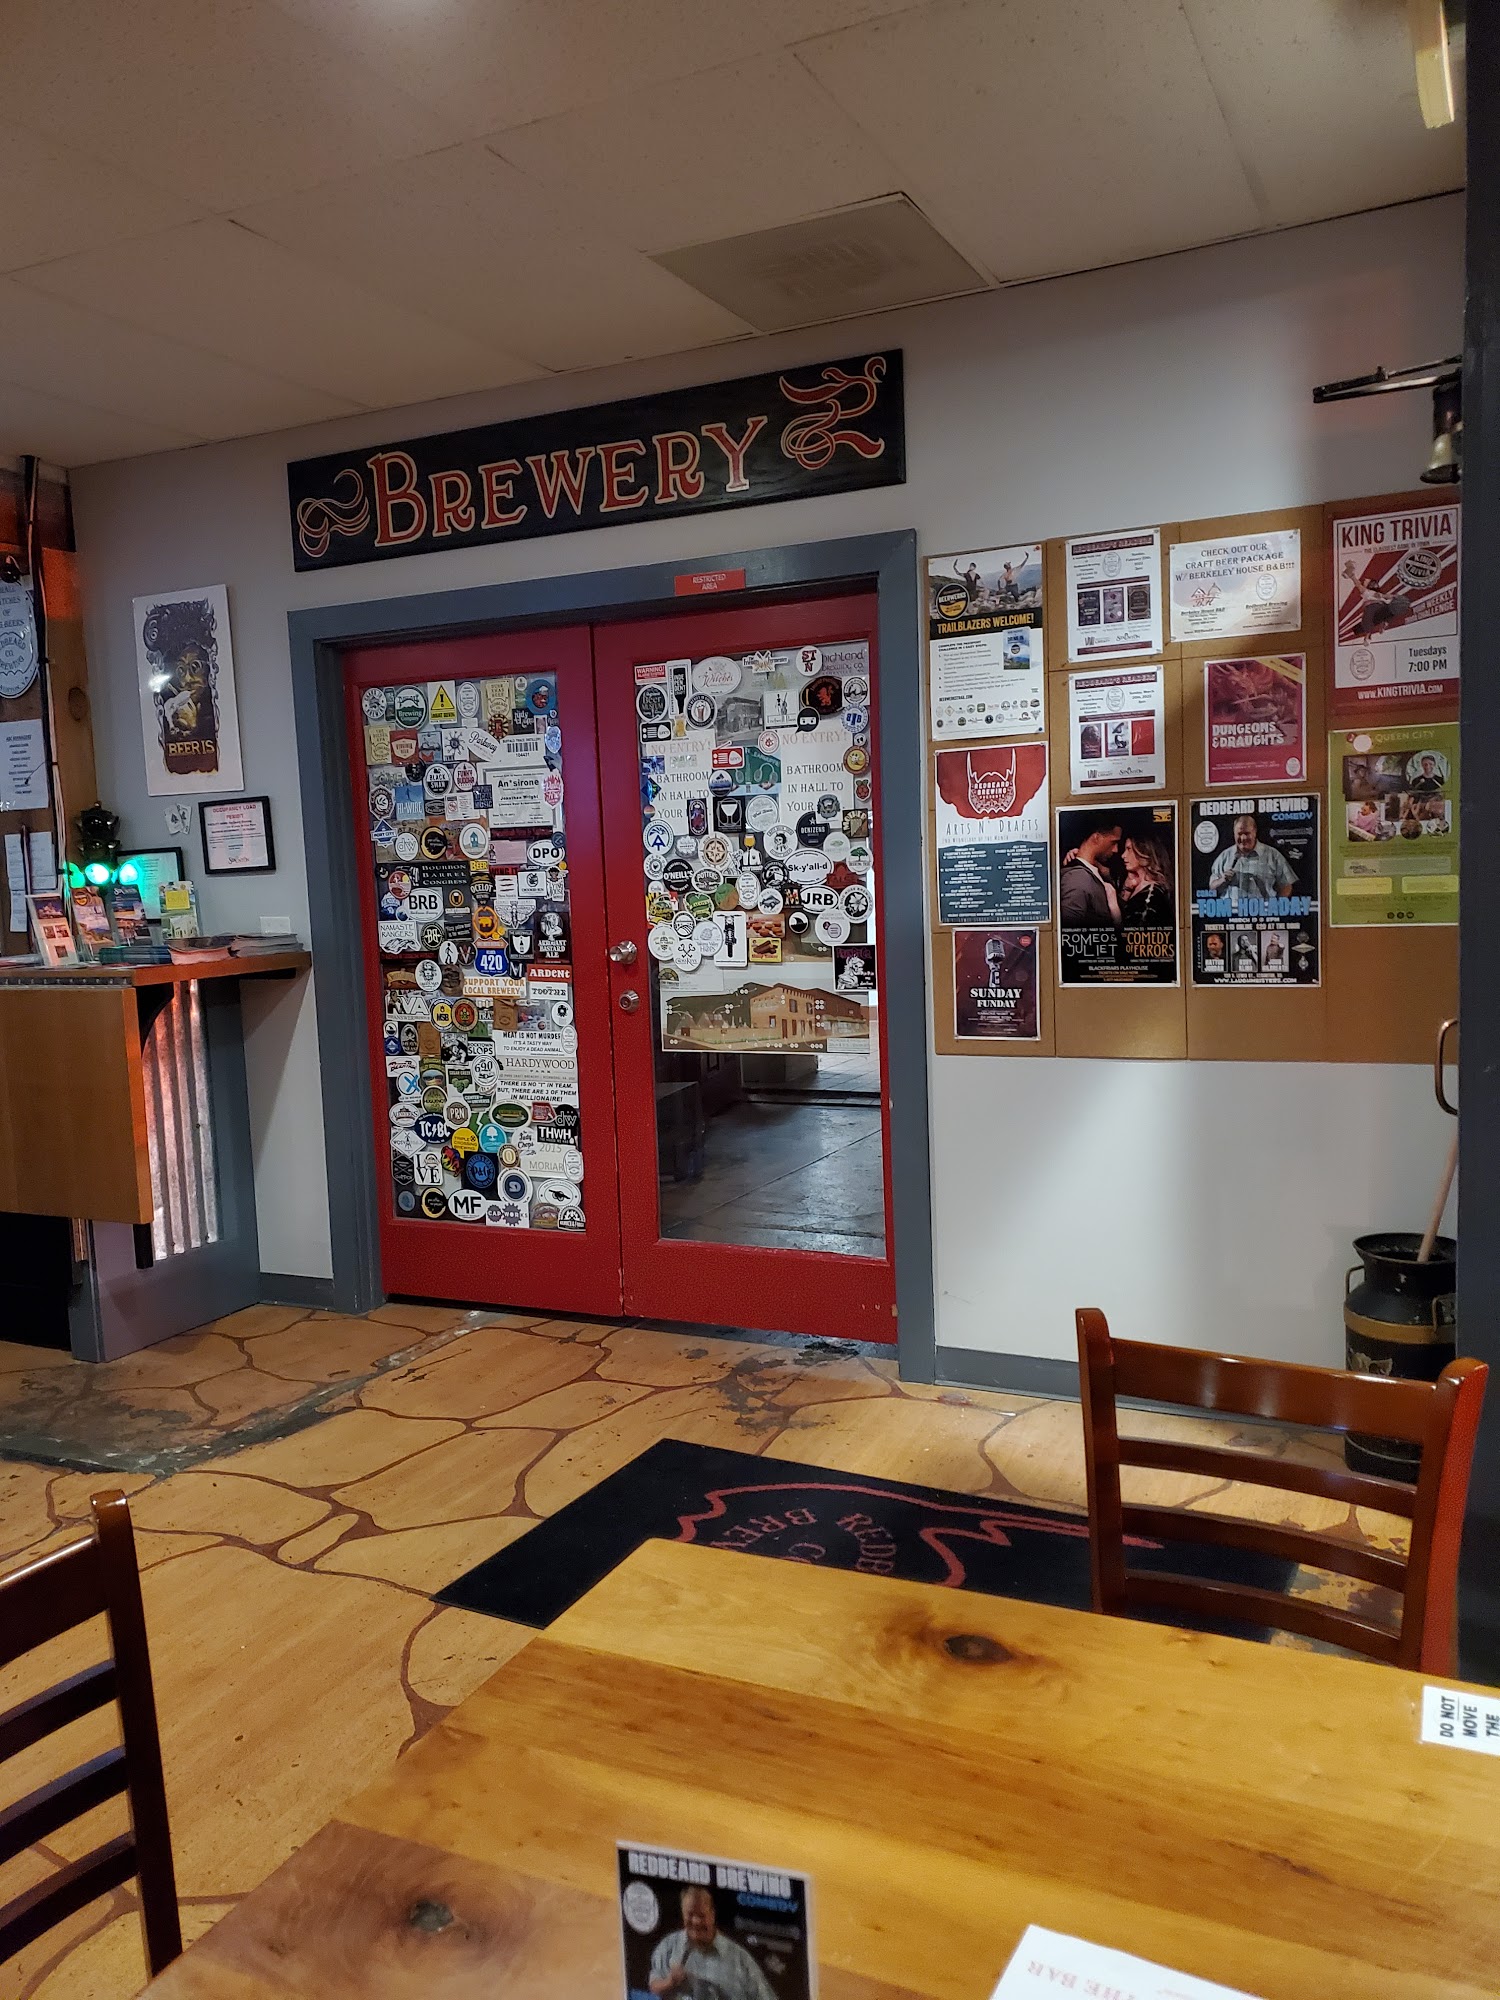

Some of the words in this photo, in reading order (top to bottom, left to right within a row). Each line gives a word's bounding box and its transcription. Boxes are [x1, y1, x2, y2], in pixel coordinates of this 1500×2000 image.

[1342, 523, 1384, 548] KING
[1390, 514, 1452, 541] TRIVIA
[1201, 548, 1229, 557] CHECK
[1250, 543, 1267, 551] OUR
[1186, 560, 1213, 569] CRAFT
[1216, 558, 1238, 566] BEER
[1241, 552, 1284, 562] PACKAGE
[693, 574, 726, 583] RESTRICTED
[1189, 568, 1233, 579] BERKELEY
[1237, 565, 1263, 574] HOUSE
[937, 620, 991, 634] TRAILBLAZERS
[992, 613, 1034, 627] WELCOME!
[1408, 646, 1447, 657] Tuesdays
[1408, 661, 1430, 673] 7:00
[1433, 659, 1447, 670] PM
[1212, 722, 1276, 736] DUNGEONS
[783, 734, 798, 745] NO
[803, 730, 848, 744] ENTRY!
[1220, 734, 1284, 748] DRAUGHTS
[1375, 732, 1409, 743] QUEEN
[1412, 730, 1435, 740] CITY
[202, 740, 216, 754] IS
[651, 745, 665, 755] NO
[670, 741, 711, 753] ENTRY!
[787, 763, 844, 775] BATHROOM
[656, 772, 709, 783] BATHROOM
[788, 784, 797, 793] IN
[801, 783, 827, 792] HALL
[830, 782, 843, 790] TO
[975, 781, 1009, 789] REDBEARD
[977, 787, 1007, 795] BREWING
[670, 791, 694, 800] HALL
[697, 790, 709, 798] TO
[397, 802, 423, 814] HI-WIRE
[787, 801, 814, 811] YOUR
[1200, 800, 1255, 816] REDBEARD
[1258, 797, 1309, 813] BREWING
[657, 809, 683, 818] YOUR
[1272, 812, 1313, 820] COMEDY
[947, 823, 971, 835] ARTS
[979, 820, 990, 833] N'
[1000, 819, 1038, 832] DRAFTS
[533, 848, 559, 858] DPO
[471, 861, 488, 871] BEER
[788, 863, 828, 872] Sk-y'all-d
[664, 870, 693, 880] O'NEILL'S
[470, 883, 493, 893] OCELOT
[409, 895, 438, 910] BRB
[802, 893, 834, 906] JRB
[1197, 898, 1232, 918] TOM
[1062, 934, 1109, 946] ROMEO
[1127, 932, 1170, 944] COMEDY
[1067, 944, 1118, 956] JULIET
[1126, 945, 1133, 953] OF
[1134, 944, 1175, 957] ERRORS
[480, 955, 502, 970] 420
[970, 988, 1022, 999] SUNDAY
[977, 1000, 1016, 1008] FUNDAY
[474, 1062, 492, 1073] 690
[506, 1058, 575, 1069] HARDYWOOD
[454, 1195, 481, 1214] MF
[1440, 1696, 1455, 1720] NOT
[1462, 1705, 1478, 1738] MOVE
[1485, 1714, 1500, 1737] THE
[1440, 1723, 1454, 1738] DO
[628, 1850, 711, 1886] REDBEARD
[716, 1865, 792, 1899] BREWING
